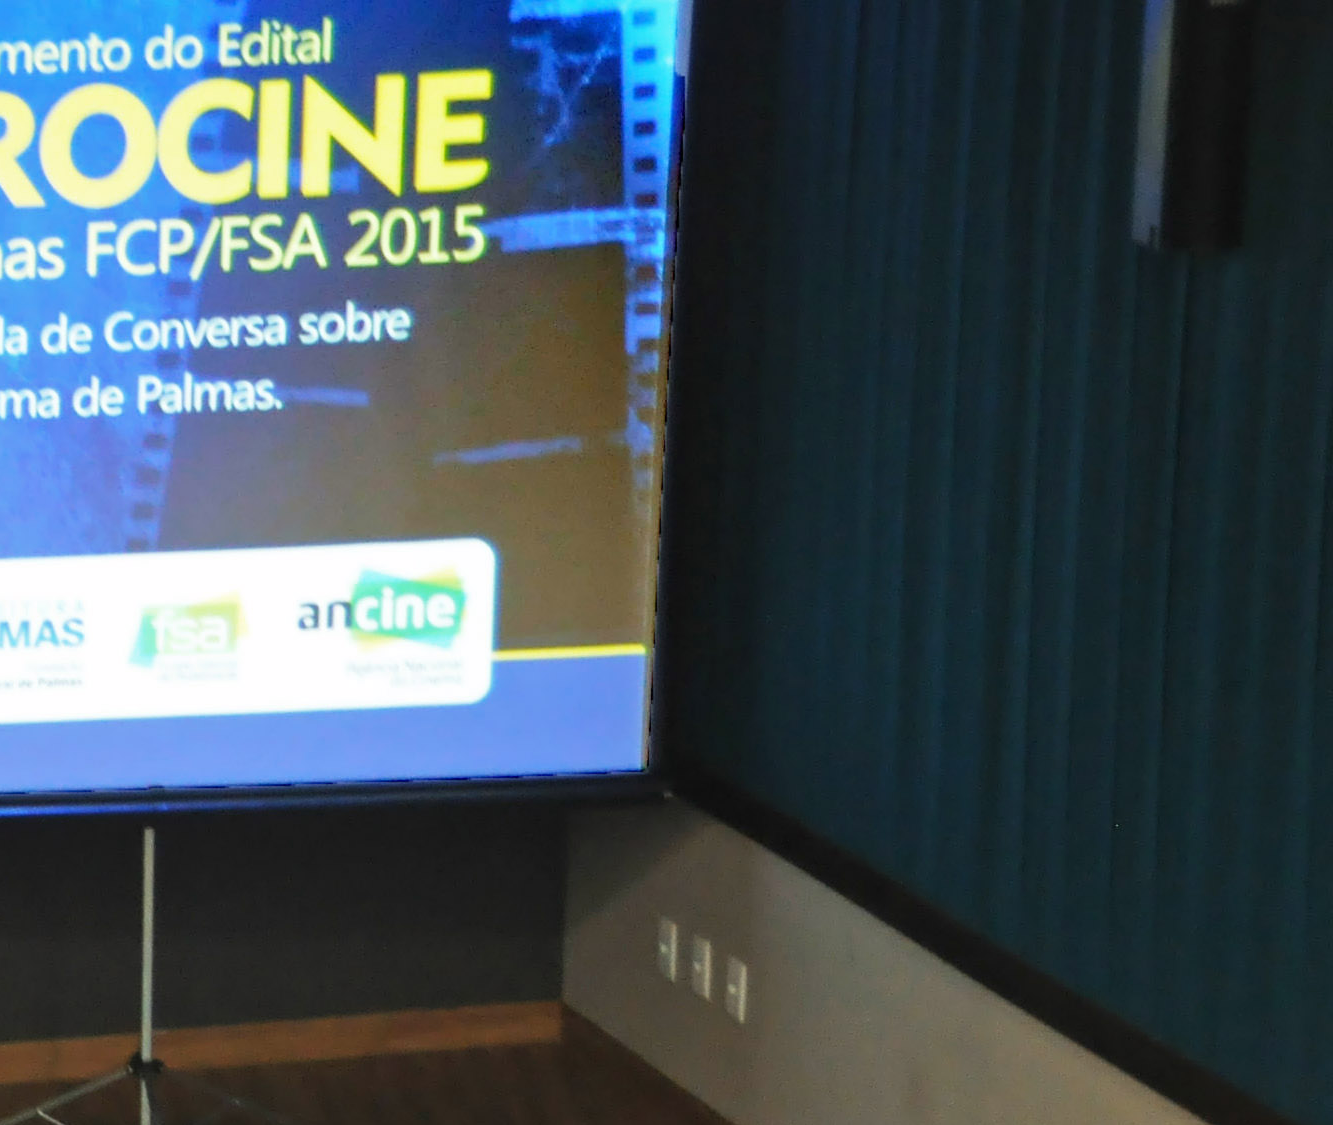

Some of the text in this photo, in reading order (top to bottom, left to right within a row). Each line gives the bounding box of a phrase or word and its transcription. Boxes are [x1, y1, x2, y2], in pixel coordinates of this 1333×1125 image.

[145, 24, 203, 69] do
[218, 16, 334, 68] Edital
[86, 211, 329, 281] FCP/FSA
[344, 204, 489, 267] 2015
[40, 311, 93, 354] de
[104, 311, 287, 352] Conversa
[298, 299, 413, 344] sobre
[73, 375, 125, 418] de
[137, 371, 284, 414] Palmas.
[297, 587, 455, 631] ancine
